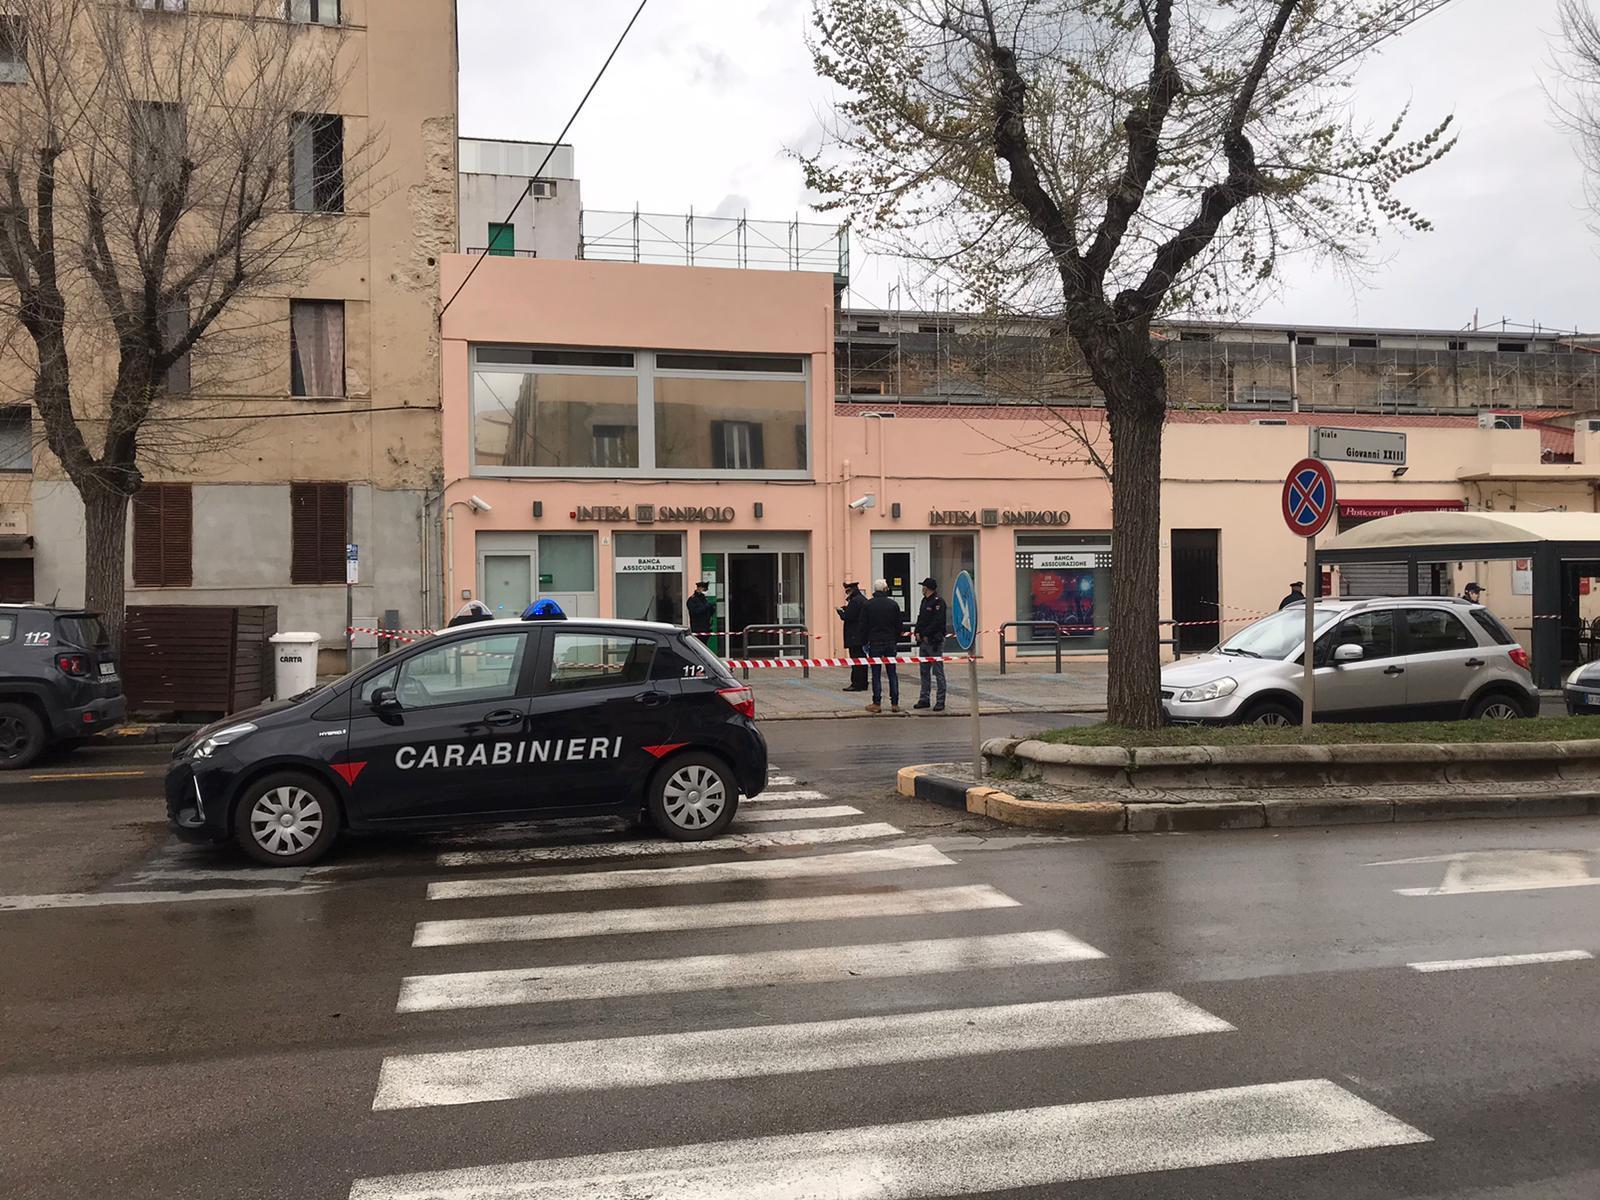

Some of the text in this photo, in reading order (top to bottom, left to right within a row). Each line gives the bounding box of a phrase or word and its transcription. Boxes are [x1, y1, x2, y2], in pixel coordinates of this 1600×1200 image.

[1346, 447, 1404, 460] Giovanni XXIII
[577, 506, 735, 522] INTESA SANPAOLO
[929, 510, 1071, 526] INTESA SANPAOLO
[24, 632, 51, 643] 112
[682, 665, 705, 677] 112
[395, 736, 623, 769] CARABINIERI
